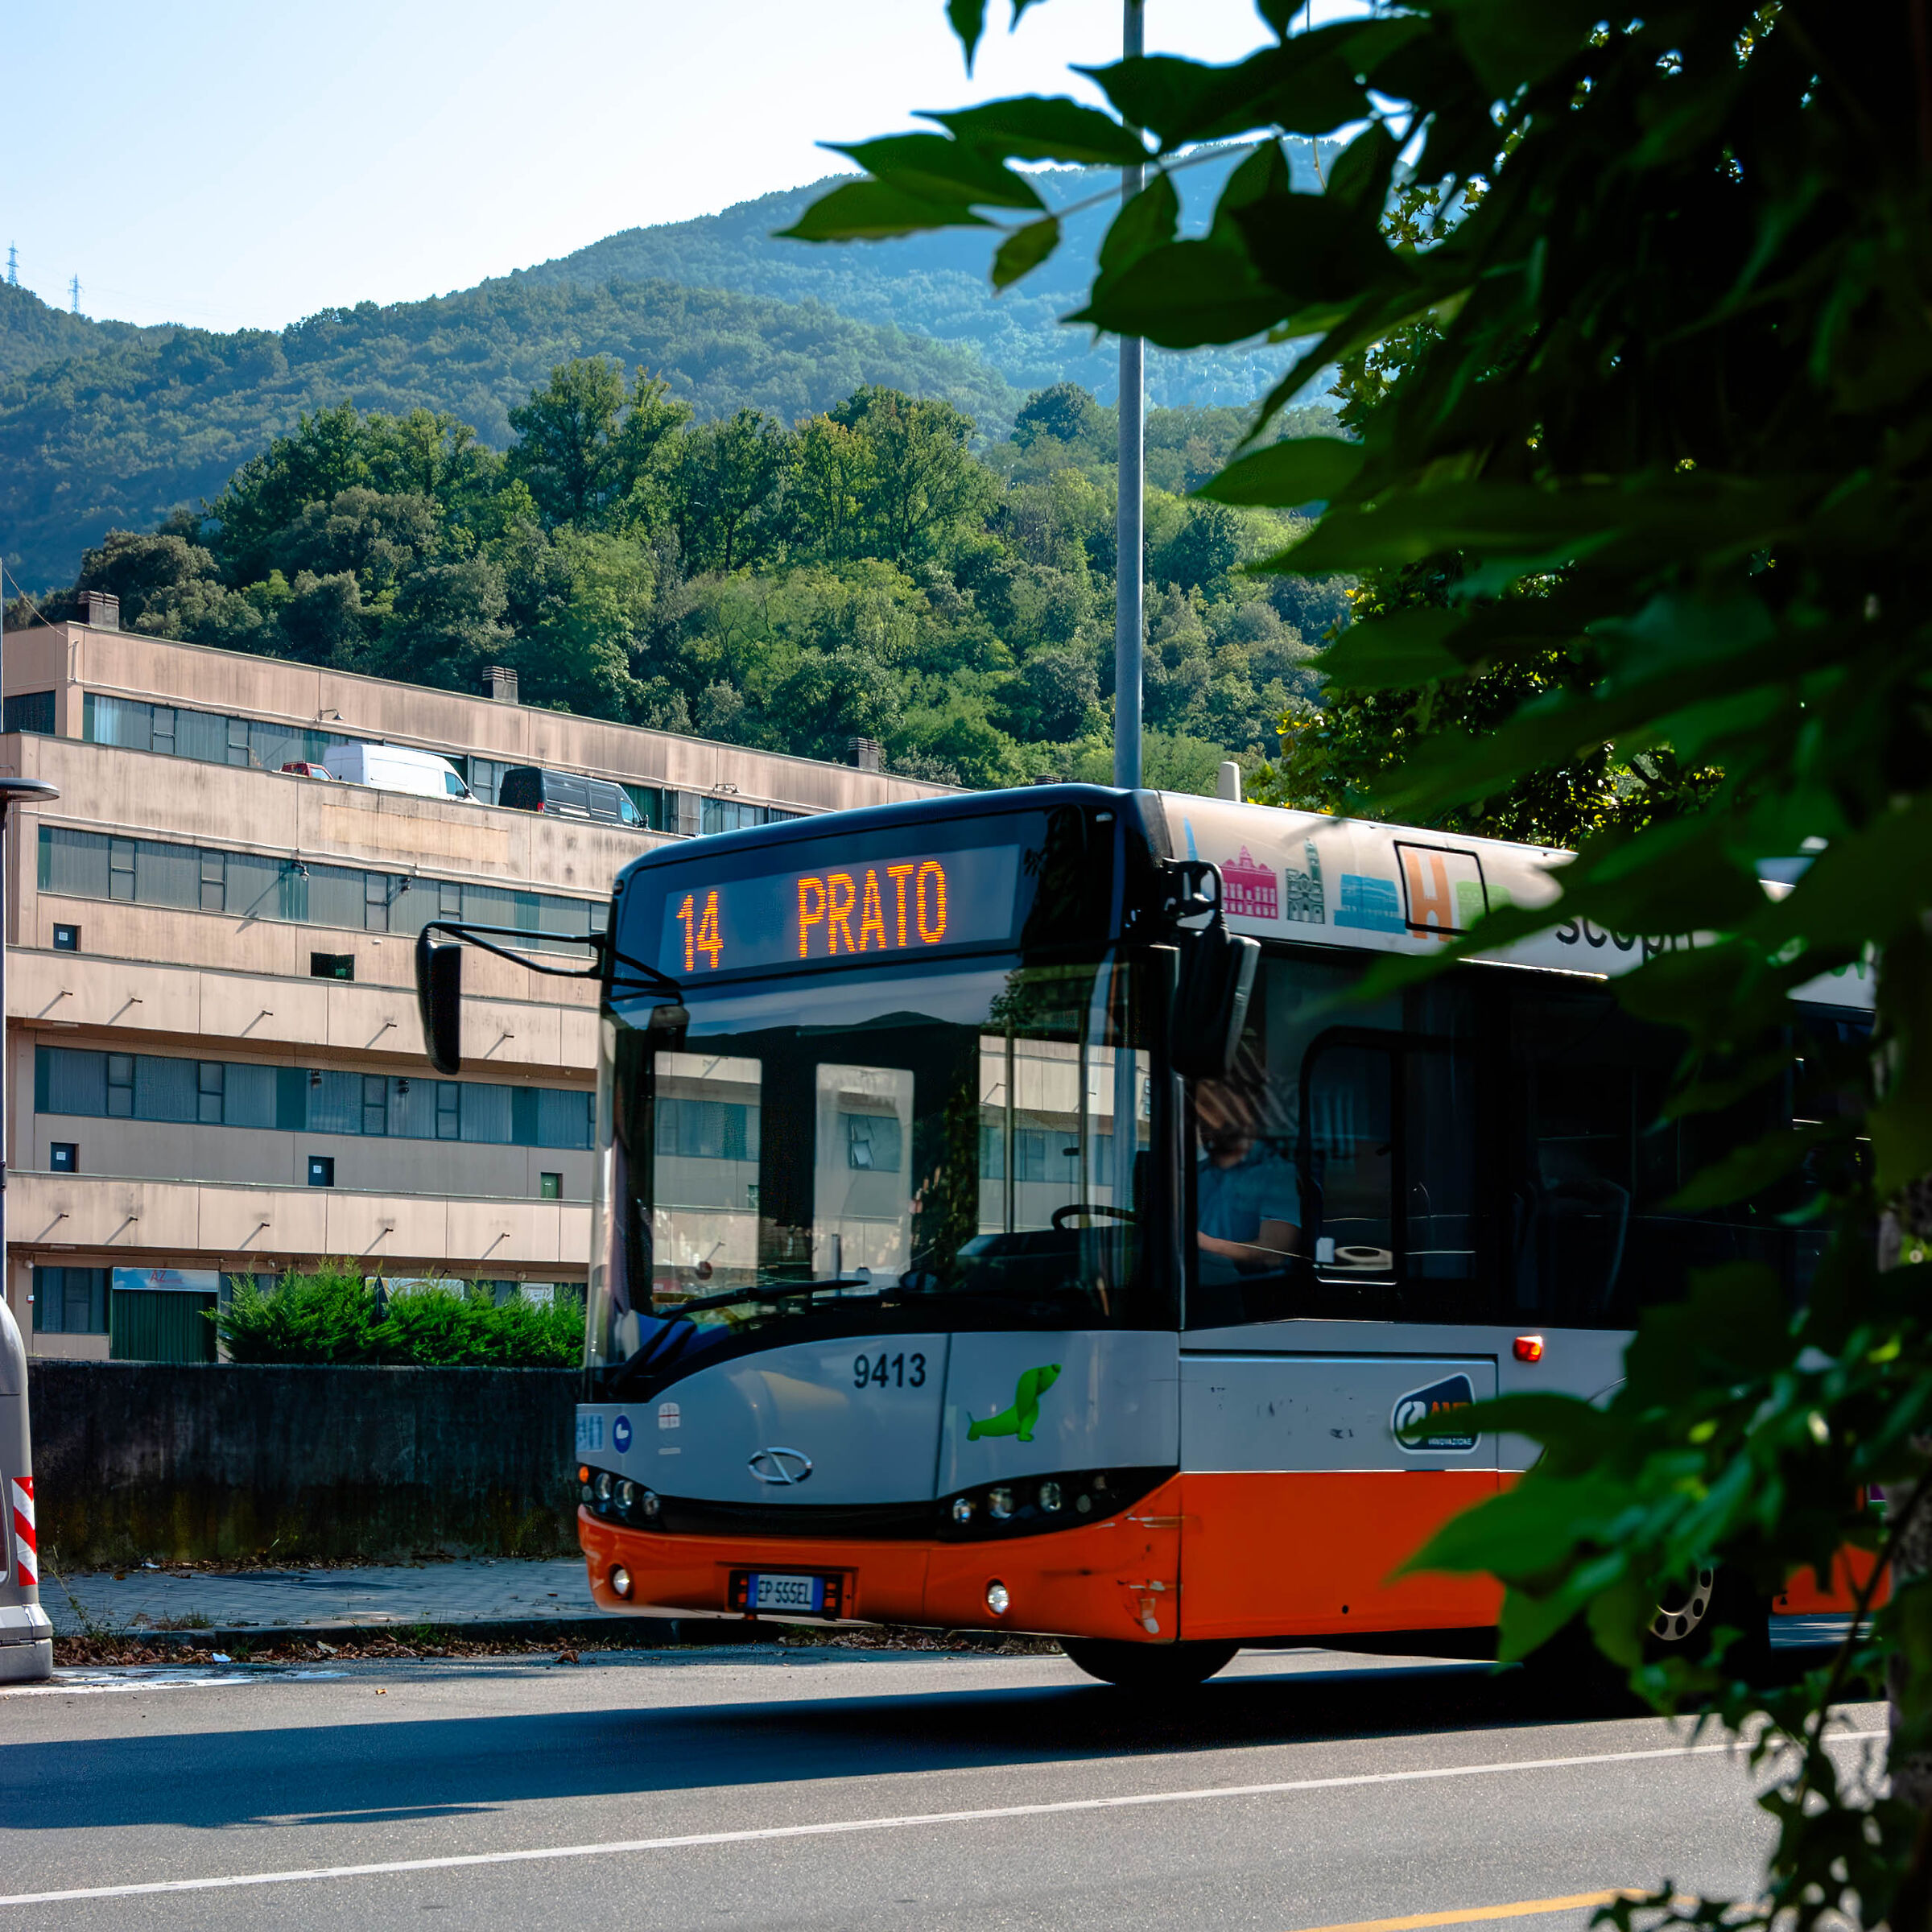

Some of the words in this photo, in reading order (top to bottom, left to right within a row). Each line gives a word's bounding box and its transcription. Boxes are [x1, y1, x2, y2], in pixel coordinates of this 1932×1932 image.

[676, 891, 724, 971] 14
[798, 861, 947, 957] PRATO
[854, 1352, 926, 1389] 9413
[758, 1580, 773, 1602] EP
[775, 1582, 811, 1604] 555EL
